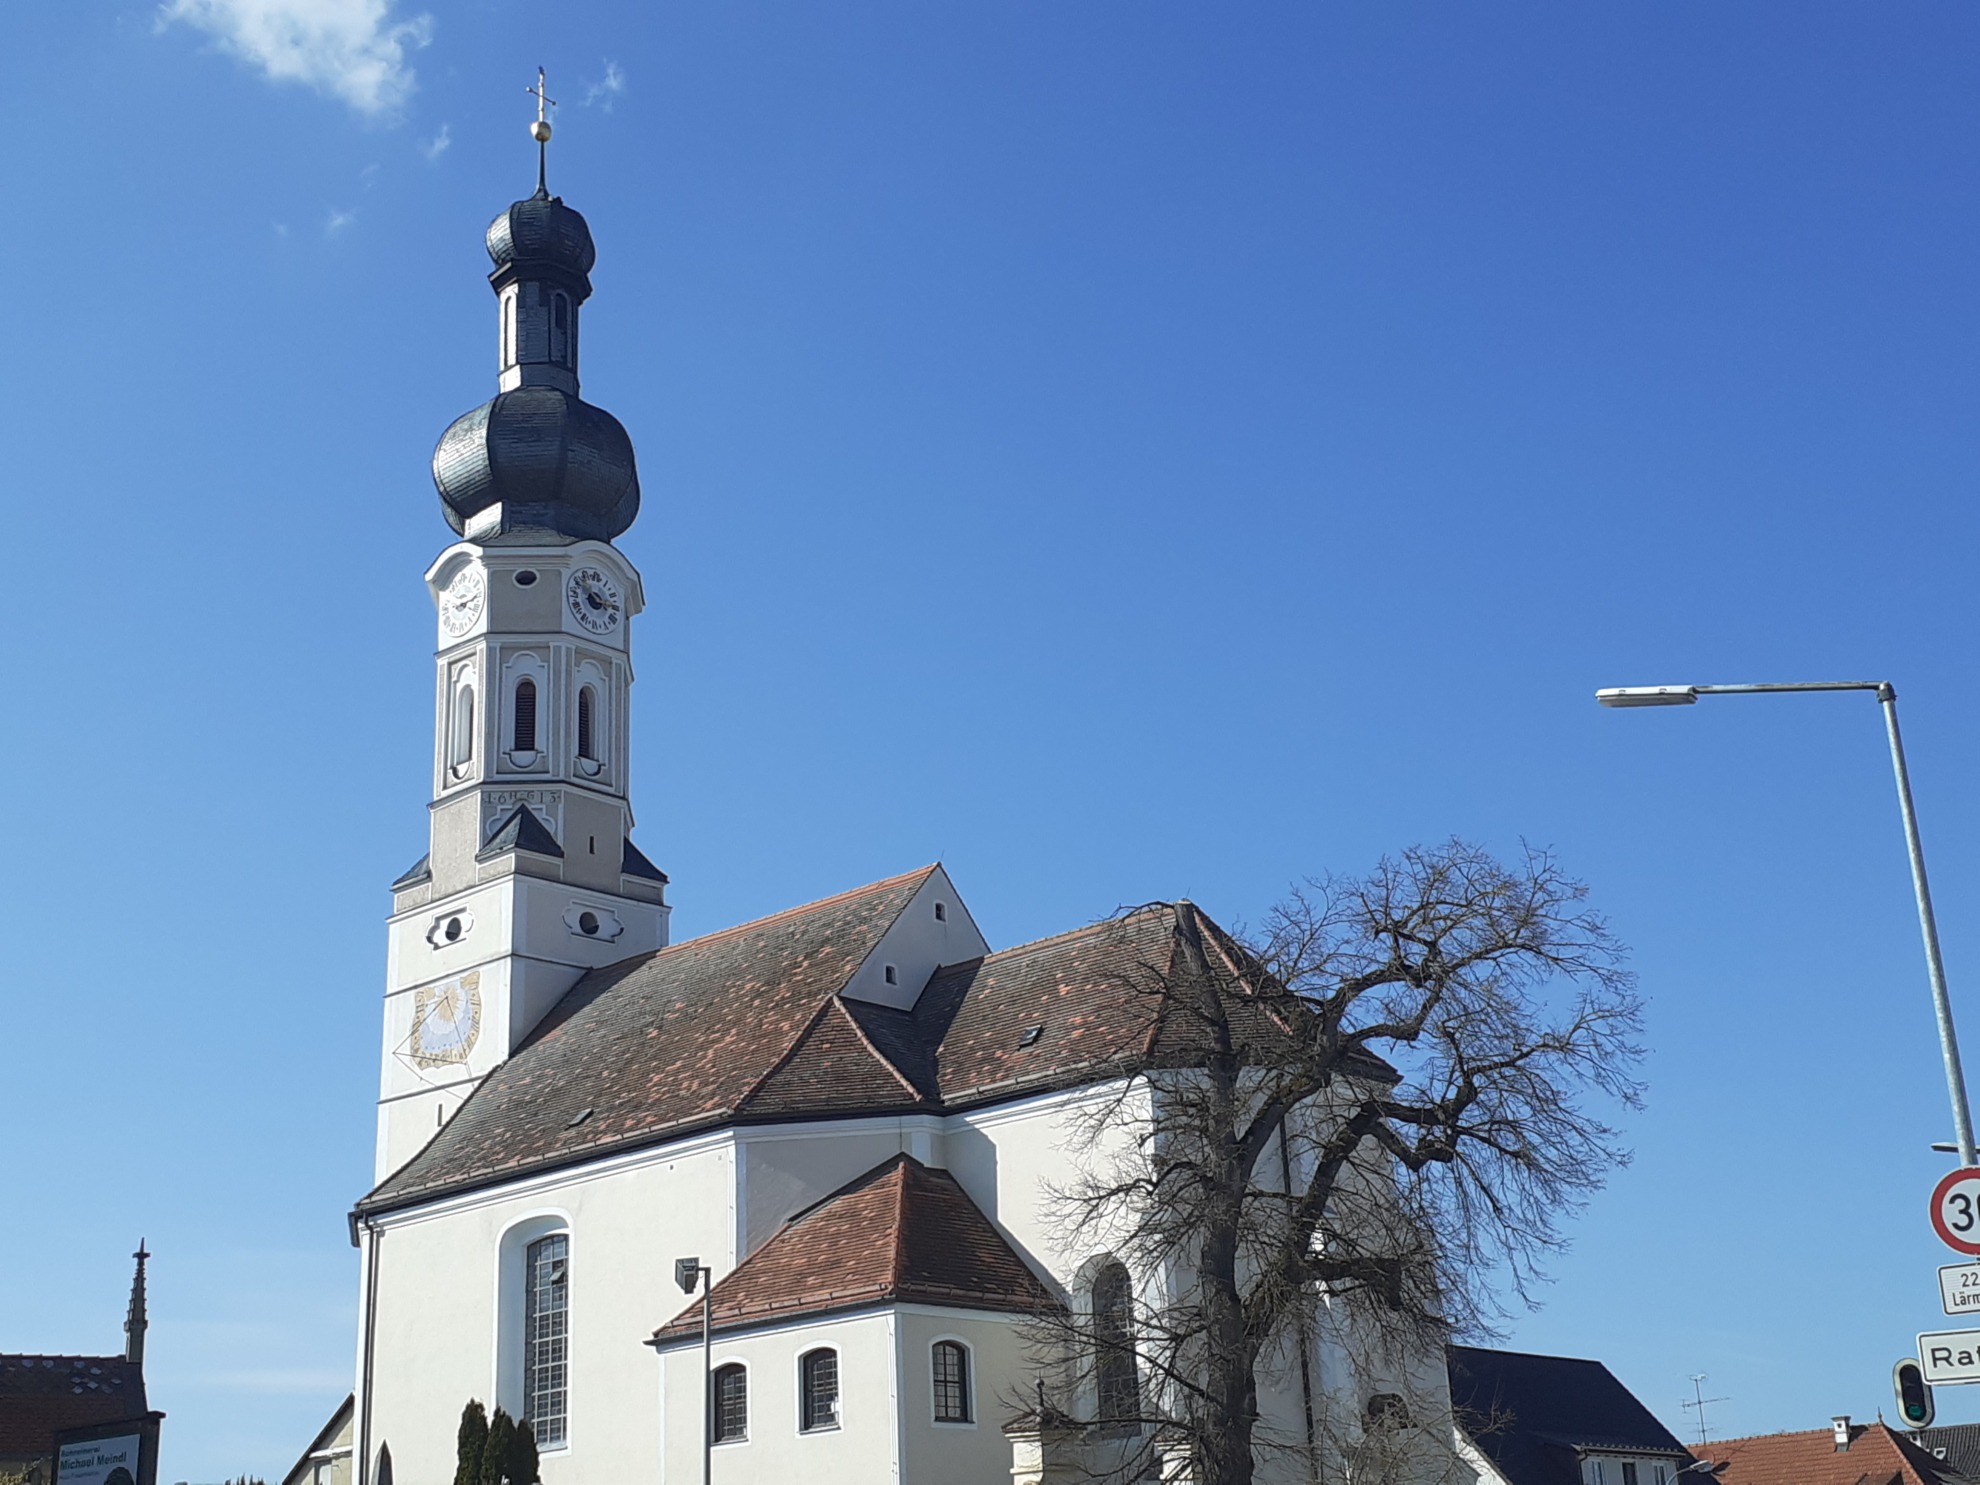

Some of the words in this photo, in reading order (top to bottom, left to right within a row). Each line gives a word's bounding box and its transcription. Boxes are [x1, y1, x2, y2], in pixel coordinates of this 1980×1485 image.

[1948, 1192, 1980, 1232] 3
[60, 1455, 95, 1471] Michael
[97, 1451, 127, 1466] Meindl
